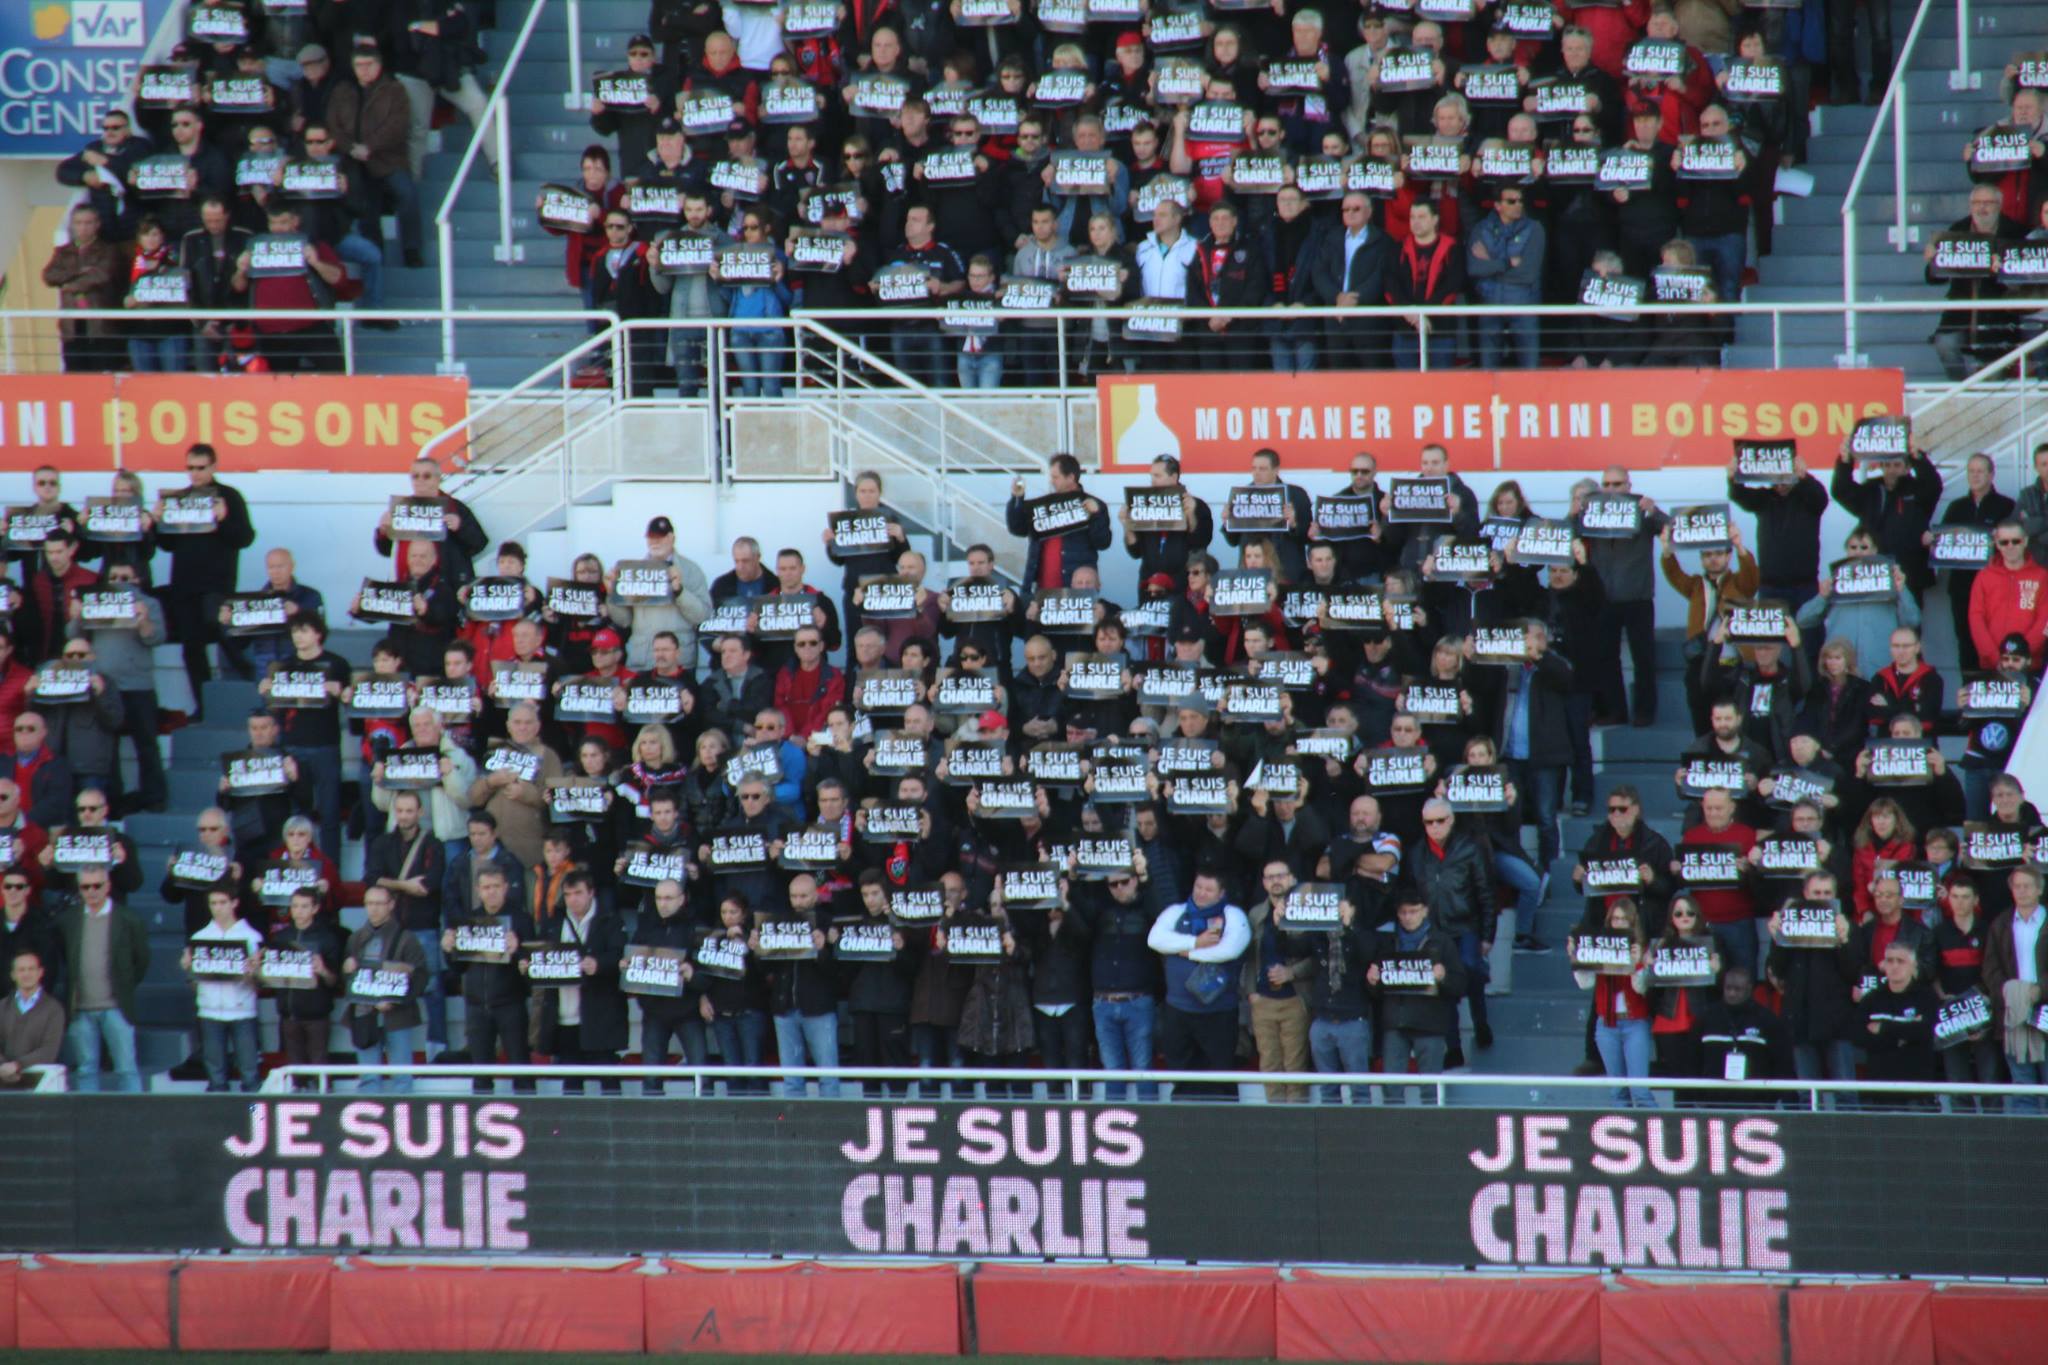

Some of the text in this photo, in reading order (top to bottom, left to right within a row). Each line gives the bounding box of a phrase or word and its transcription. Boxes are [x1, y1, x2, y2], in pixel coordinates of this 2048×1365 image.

[1629, 45, 1679, 58] JE SUIS
[1380, 53, 1430, 69] JE SUIS
[1627, 58, 1679, 72] CHARLIE
[1380, 66, 1432, 83] CHARLIE
[768, 86, 813, 99] JE SUIS
[767, 99, 814, 113] CHARLIE
[1192, 105, 1242, 119] JE SUIS
[1, 96, 121, 135] GÉNÉ
[1190, 118, 1243, 133] CHARLIE
[1548, 148, 1595, 161] JE SUIS
[1057, 158, 1104, 170] JE SUIS
[1547, 161, 1596, 174] CHARLIE
[1056, 171, 1105, 184] CHARLIE
[629, 188, 677, 199] JE SUIS
[629, 200, 680, 212] CHARLIE
[796, 237, 844, 250] JE SUIS
[1938, 241, 1989, 253] JE SUIS
[794, 249, 845, 263] CHARLIE
[1935, 254, 1990, 267] CHARLIE
[103, 402, 446, 446] BOISSONS
[1195, 406, 1392, 440] MONTANER
[1413, 403, 1610, 438] PIETRINI
[1740, 449, 1791, 460] JE SUIS
[1740, 461, 1793, 474] CHARLIE
[1396, 485, 1442, 495] JE SUIS
[1131, 495, 1181, 507] JE SUIS
[1396, 496, 1444, 508] CHARLIE
[1586, 500, 1636, 513] JE SUIS
[1131, 507, 1183, 521] CHARLIE
[1584, 514, 1636, 528] CHARLIE
[836, 516, 886, 533] JE SUIS
[835, 528, 889, 547] CHARLIE
[1938, 531, 1989, 545] JE SUIS
[1935, 545, 1989, 560] CHARLIE
[619, 569, 667, 581] JE SUIS
[1837, 563, 1889, 579] JE SUIS
[472, 584, 520, 598] JE SUIS
[617, 582, 667, 595] CHARLIE
[866, 584, 913, 597] JE SUIS
[1836, 576, 1891, 594] CHARLIE
[470, 597, 521, 611] CHARLIE
[864, 596, 914, 610] CHARLIE
[1042, 597, 1093, 610] JE SUIS
[1329, 595, 1379, 606] JE SUIS
[1041, 610, 1094, 624] CHARLIE
[1329, 607, 1382, 619] CHARLIE
[1732, 608, 1783, 621] JE SUIS
[1474, 629, 1523, 641] JE SUIS
[1730, 621, 1784, 635] CHARLIE
[1475, 641, 1527, 655] CHARLIE
[355, 682, 404, 694] JE SUIS
[629, 686, 678, 700] JE SUIS
[1229, 686, 1278, 699] JE SUIS
[1970, 681, 2020, 693] JE SUIS
[354, 695, 405, 708] CHARLIE
[628, 699, 679, 714] CHARLIE
[1228, 699, 1279, 713] CHARLIE
[1969, 694, 2021, 708] CHARLIE
[949, 749, 999, 762] JE SUIS
[1873, 746, 1925, 760] JE SUIS
[949, 762, 1002, 775] CHARLIE
[1689, 761, 1743, 774] JE SUIS
[1872, 760, 1927, 776] CHARLIE
[1174, 778, 1225, 790] JE SUIS
[1449, 775, 1501, 787] JE SUIS
[1687, 774, 1744, 788] CHARLIE
[1174, 791, 1227, 804] CHARLIE
[1448, 788, 1503, 801] CHARLIE
[711, 834, 762, 850] JE SUIS
[1970, 832, 2019, 845] JE SUIS
[1078, 840, 1129, 852] JE SUIS
[1970, 845, 2021, 859] CHARLIE
[711, 847, 765, 864] CHARLIE
[1078, 852, 1131, 866] CHARLIE
[1683, 852, 1736, 865] JE SUIS
[1682, 865, 1738, 880] CHARLIE
[948, 927, 999, 939] JE SUIS
[947, 940, 1001, 953] CHARLIE
[1578, 935, 1629, 950] JE SUIS
[529, 951, 578, 964] JE SUIS
[1577, 949, 1631, 965] CHARLIE
[529, 964, 581, 978] CHARLIE
[1380, 959, 1433, 971] JE SUIS
[1381, 972, 1436, 984] CHARLIE
[223, 1101, 525, 1159] JE SUIS
[840, 1107, 1144, 1166] JE SUIS
[1468, 1115, 1786, 1176] JE SUIS
[224, 1167, 529, 1250] CHARLIE
[841, 1173, 1149, 1258] CHARLIE
[1470, 1182, 1791, 1270] CHARLIE
